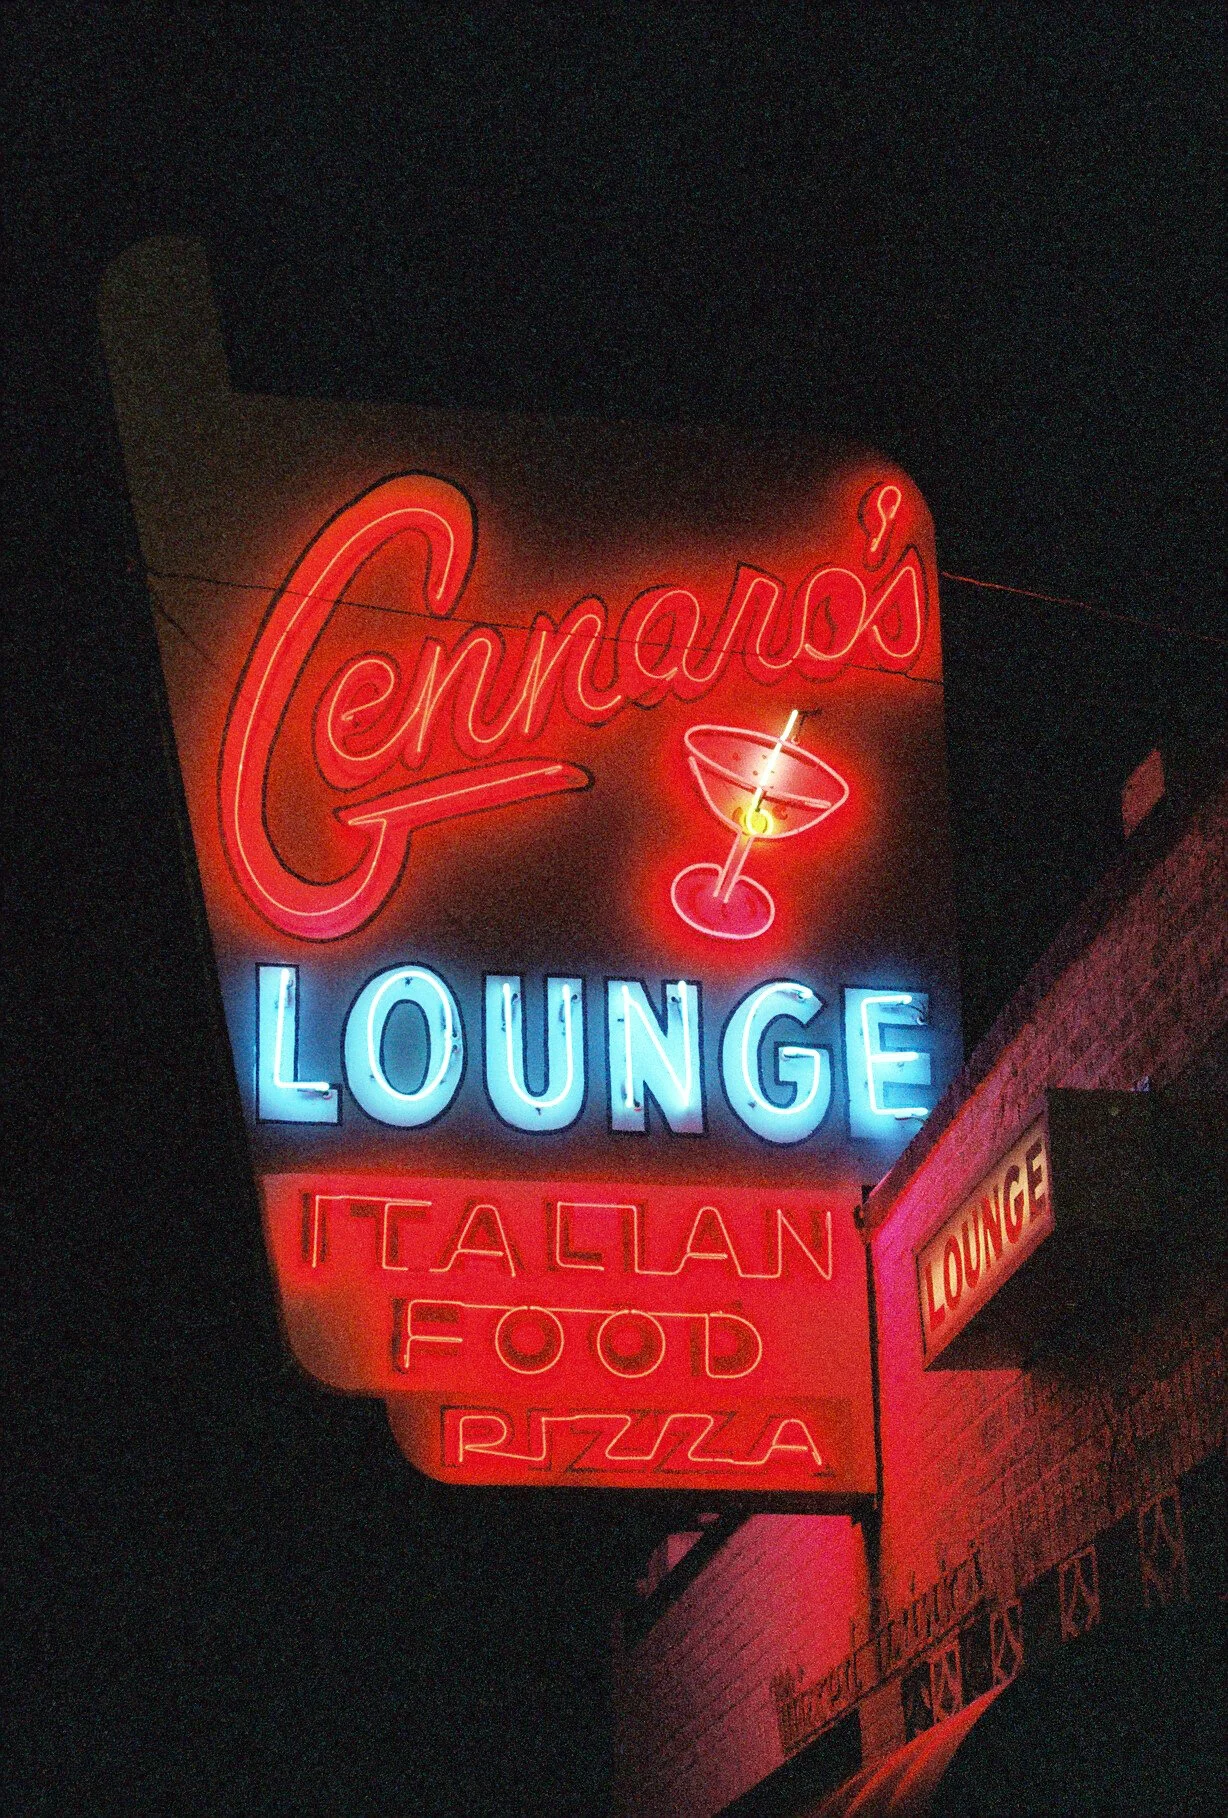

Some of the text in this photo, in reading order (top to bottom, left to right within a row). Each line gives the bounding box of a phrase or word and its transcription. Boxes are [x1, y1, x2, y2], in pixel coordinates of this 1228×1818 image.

[255, 962, 932, 1144] LOUNGE
[301, 1193, 833, 1280] ITALIAN
[924, 1143, 1046, 1327] LOUNGE
[391, 1299, 764, 1379] FOOD
[440, 1405, 836, 1476] PIZZA
